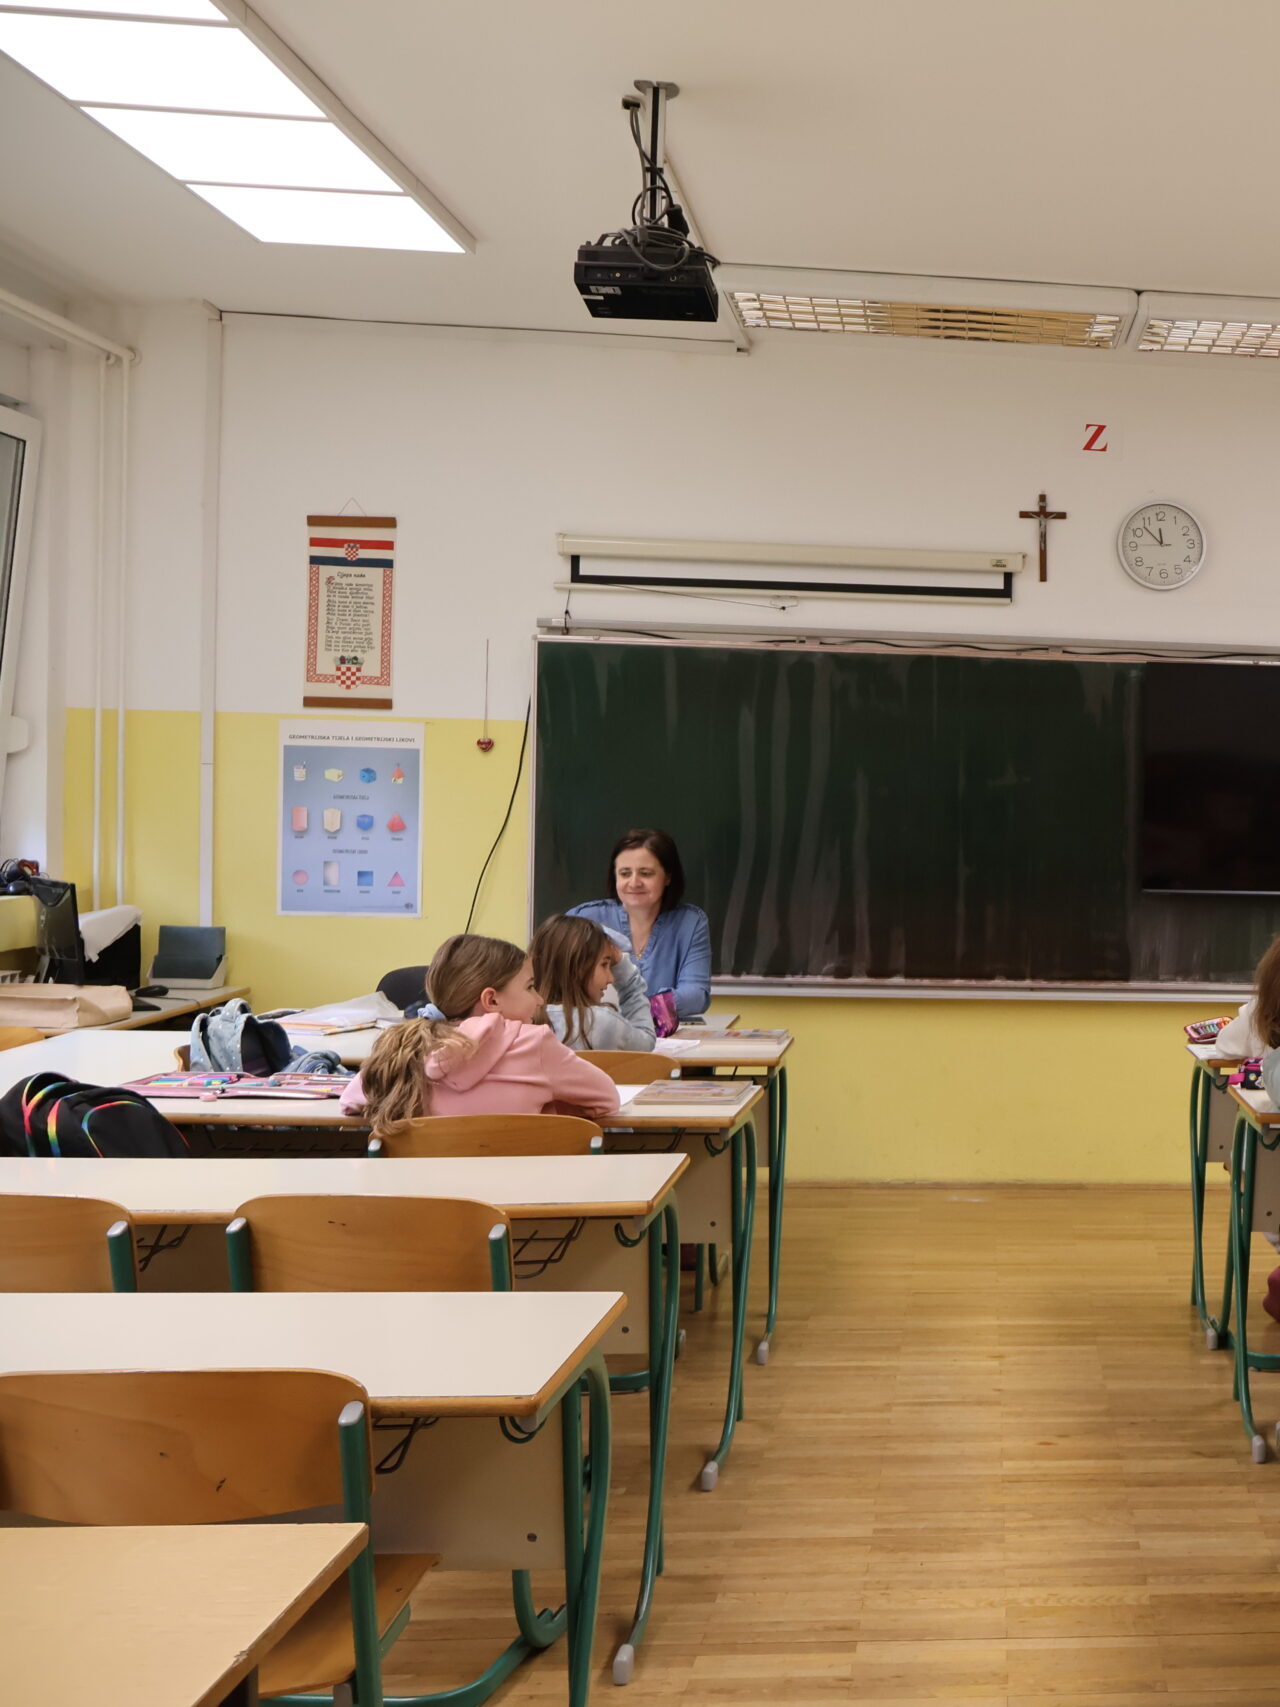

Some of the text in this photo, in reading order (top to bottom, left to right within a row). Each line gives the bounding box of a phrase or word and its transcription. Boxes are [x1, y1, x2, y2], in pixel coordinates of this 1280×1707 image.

[1082, 423, 1108, 452] Z
[1142, 516, 1151, 526] 11
[1156, 511, 1166, 521] 12
[1173, 515, 1177, 525] 1
[1132, 527, 1143, 538] 10
[1182, 526, 1190, 536] 2
[1128, 541, 1138, 551] 9
[1186, 539, 1195, 549] 3
[1134, 556, 1144, 567] 8
[1183, 555, 1192, 564] 4
[1145, 566, 1154, 576] 7
[1160, 569, 1169, 579] 6
[1174, 565, 1183, 575] 5
